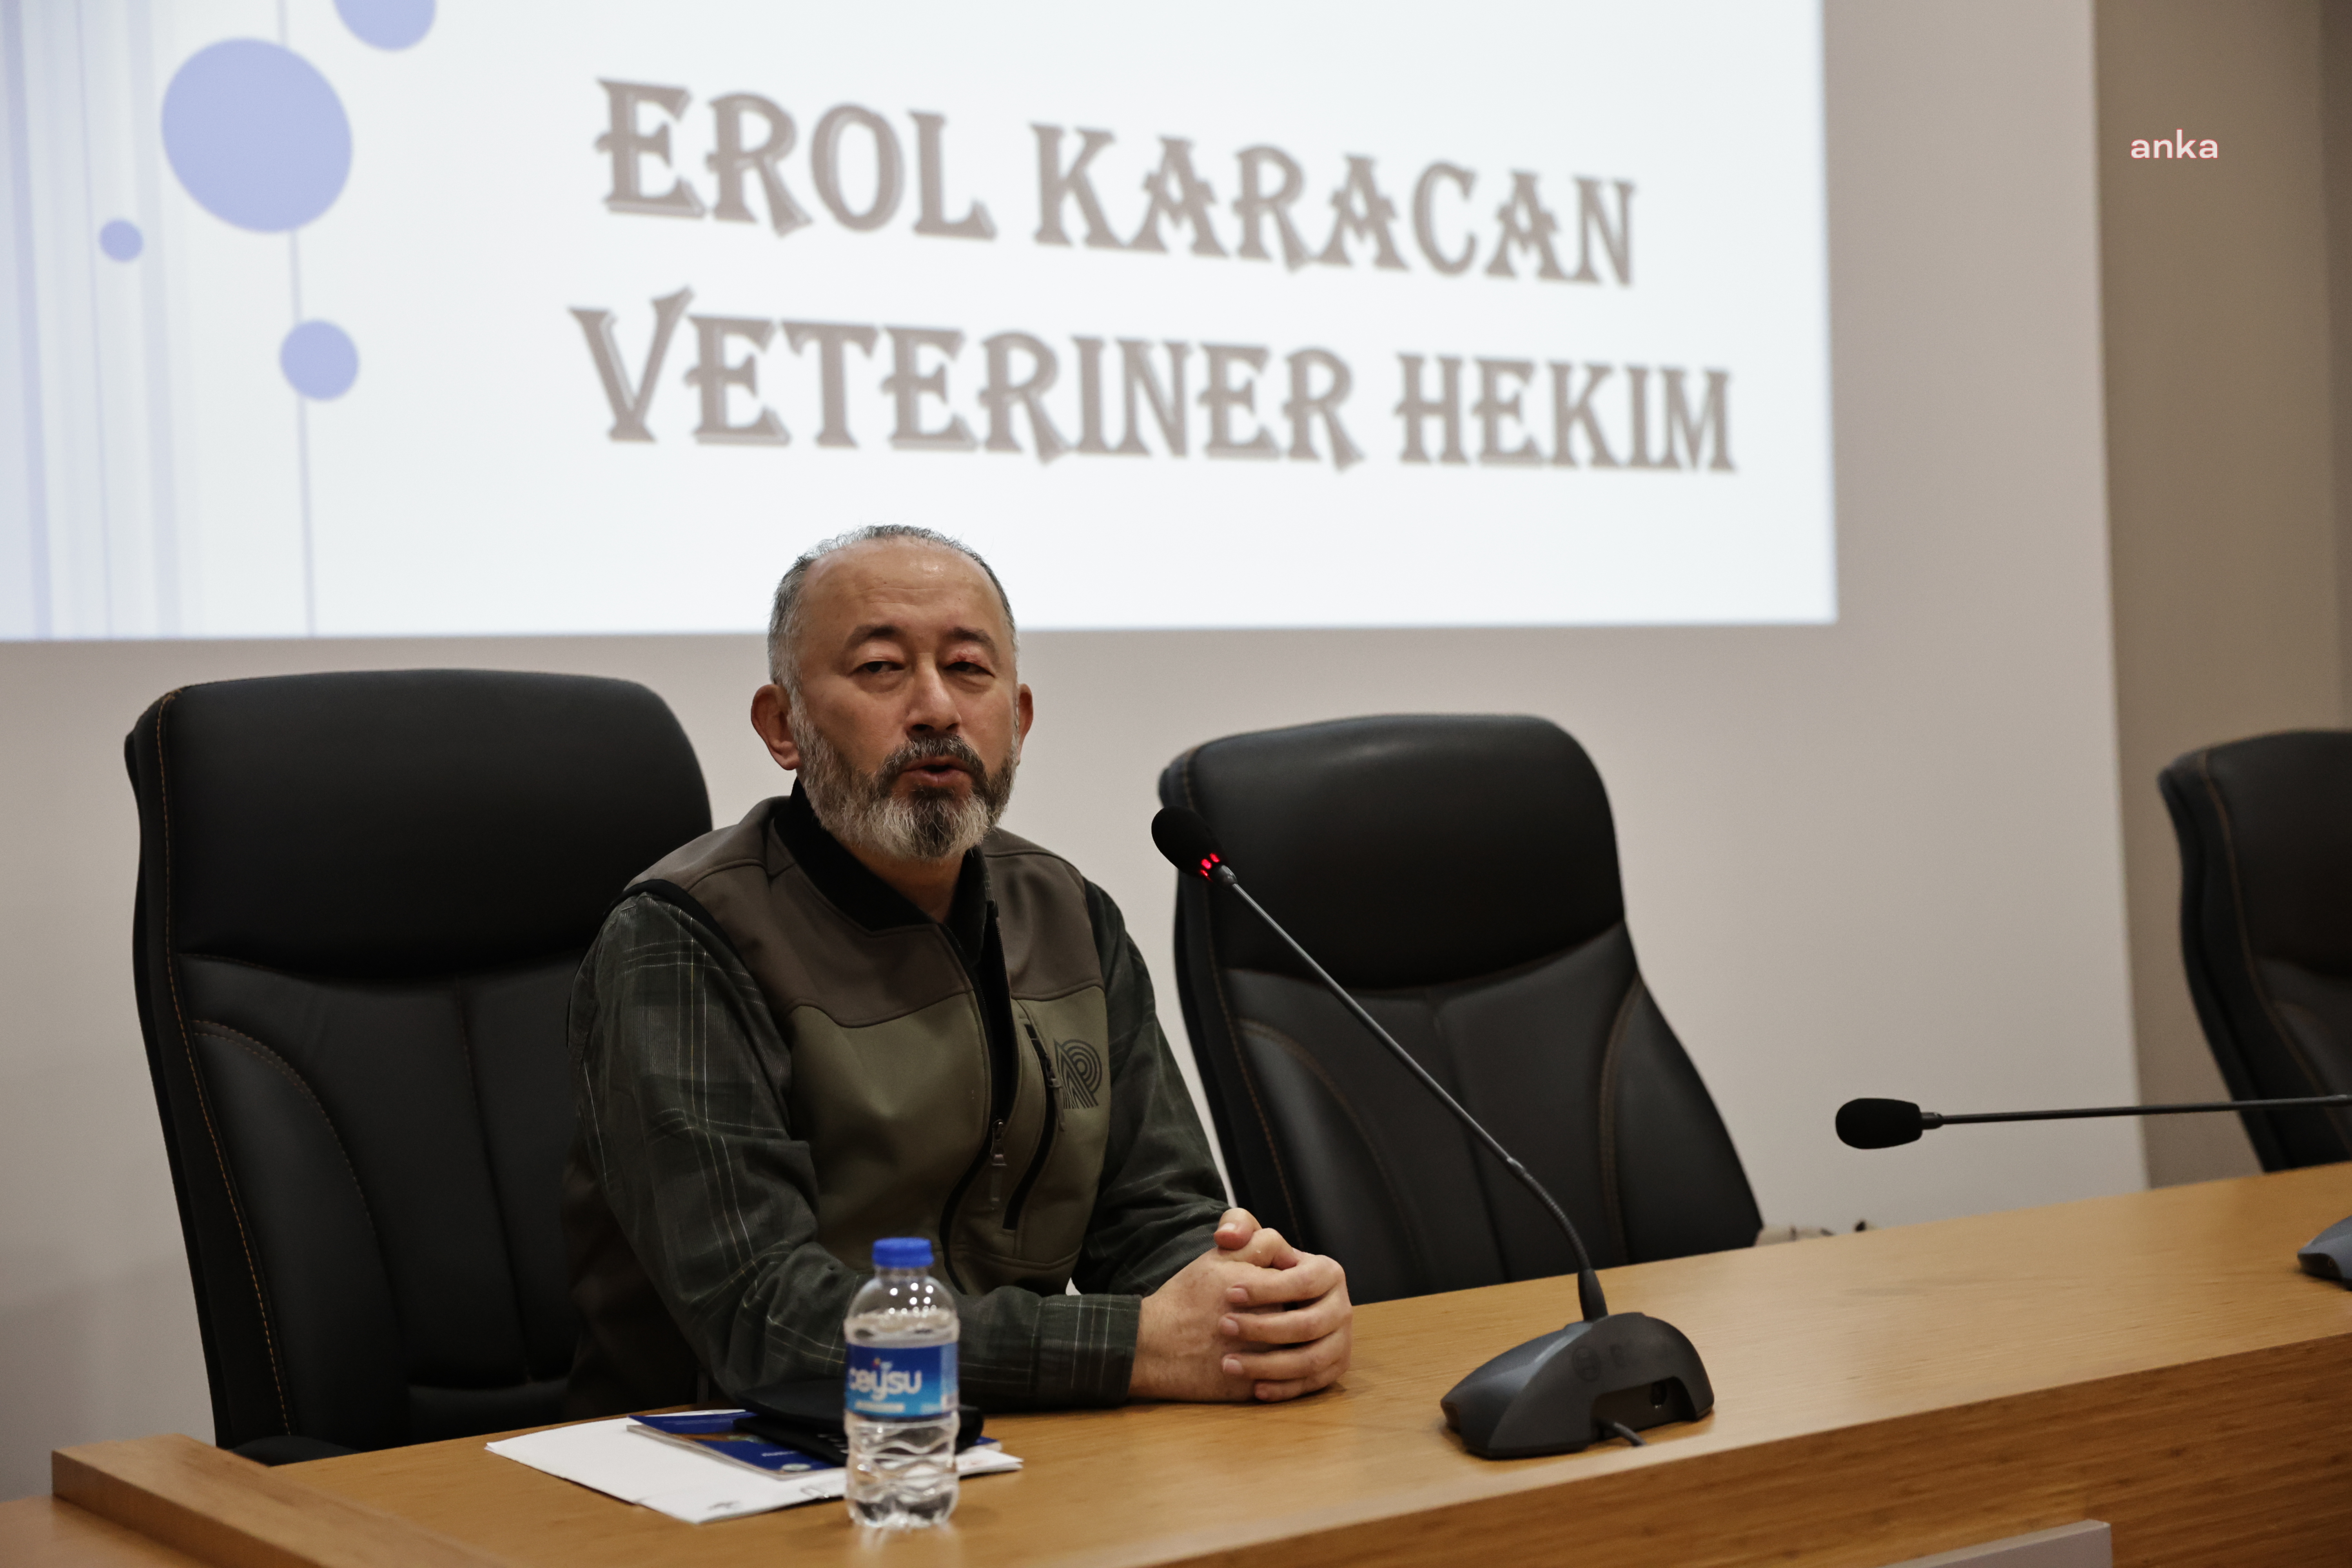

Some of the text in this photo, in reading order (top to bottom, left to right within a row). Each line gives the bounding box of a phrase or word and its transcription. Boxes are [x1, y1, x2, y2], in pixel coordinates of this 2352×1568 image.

[595, 79, 1635, 286] EROL KARACAN
[569, 288, 1735, 472] VETERINER HEKIM
